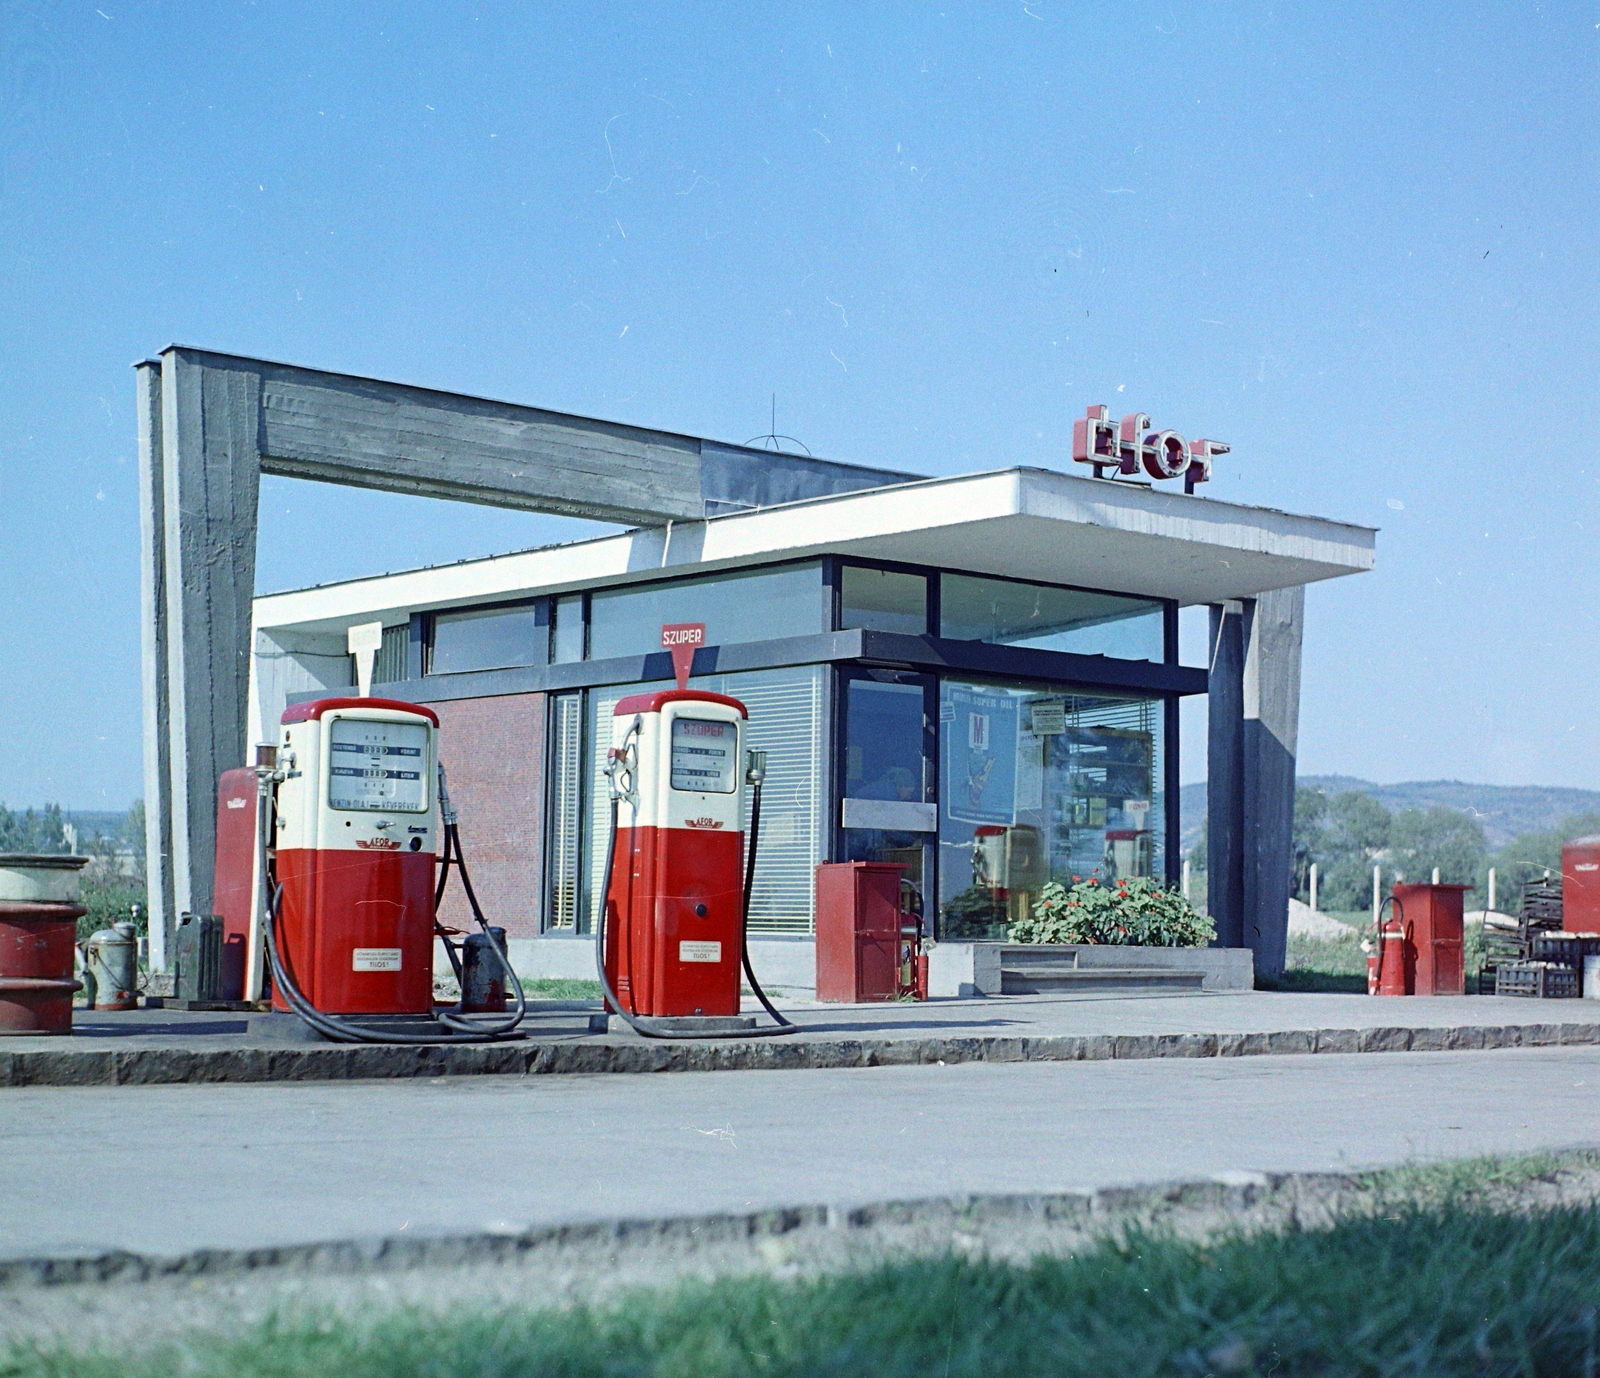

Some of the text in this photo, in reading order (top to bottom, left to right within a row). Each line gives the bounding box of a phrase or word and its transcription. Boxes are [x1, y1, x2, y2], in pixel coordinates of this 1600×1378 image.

[663, 629, 702, 645] SZUPER
[973, 696, 996, 707] SUPER
[1001, 699, 1013, 709] OIL
[683, 723, 724, 737] SZUPER
[973, 715, 984, 744] M
